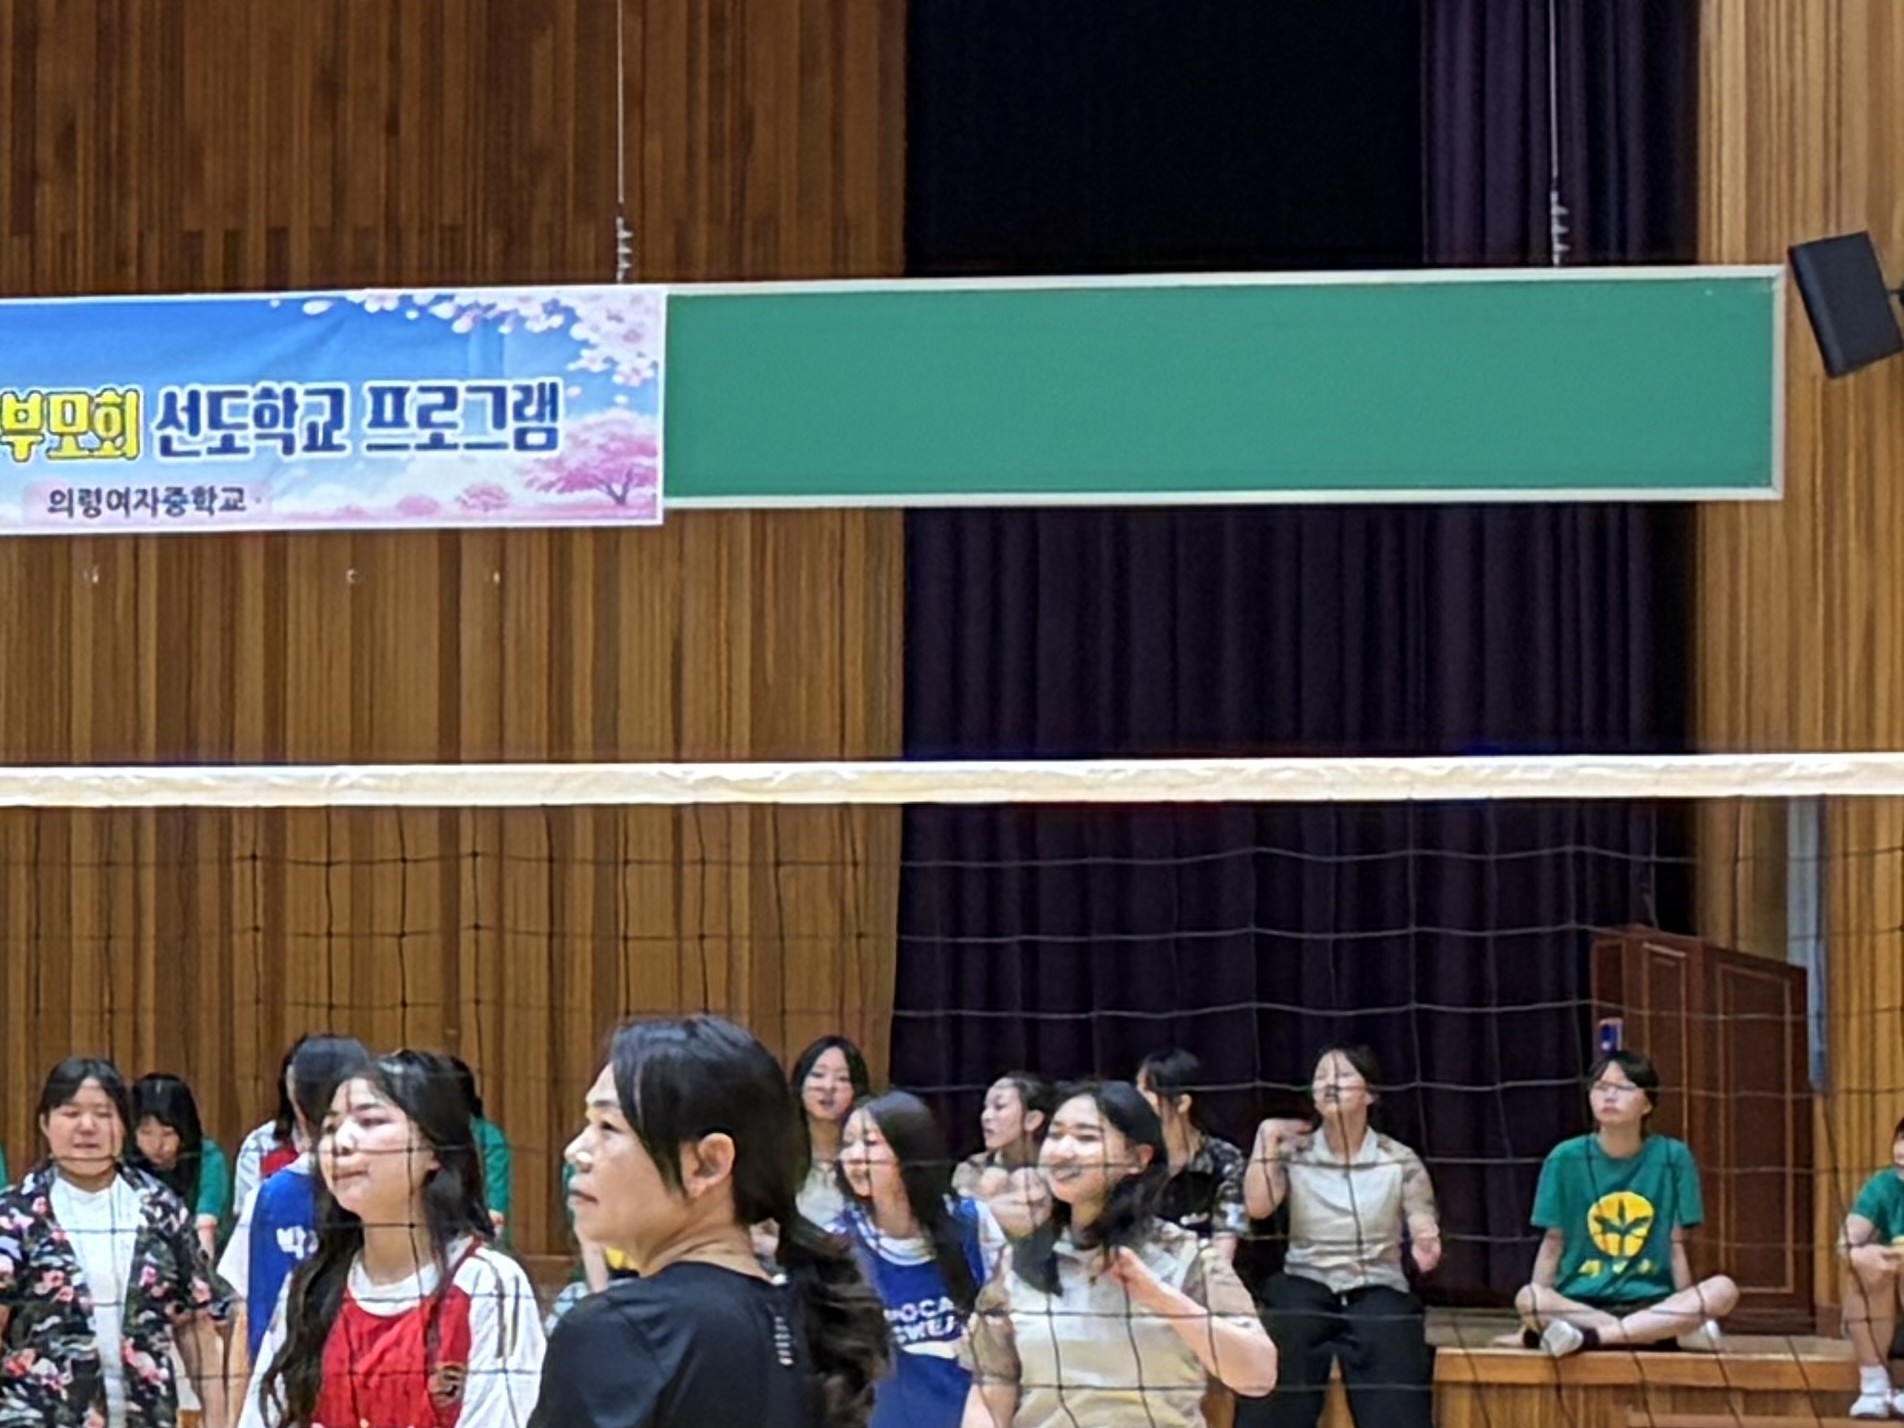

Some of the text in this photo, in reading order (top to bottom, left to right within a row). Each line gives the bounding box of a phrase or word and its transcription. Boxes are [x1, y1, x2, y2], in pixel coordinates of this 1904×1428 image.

[156, 386, 347, 457] 선도학교
[365, 381, 559, 452] 프로그램
[46, 485, 246, 519] 의령여자중학교
